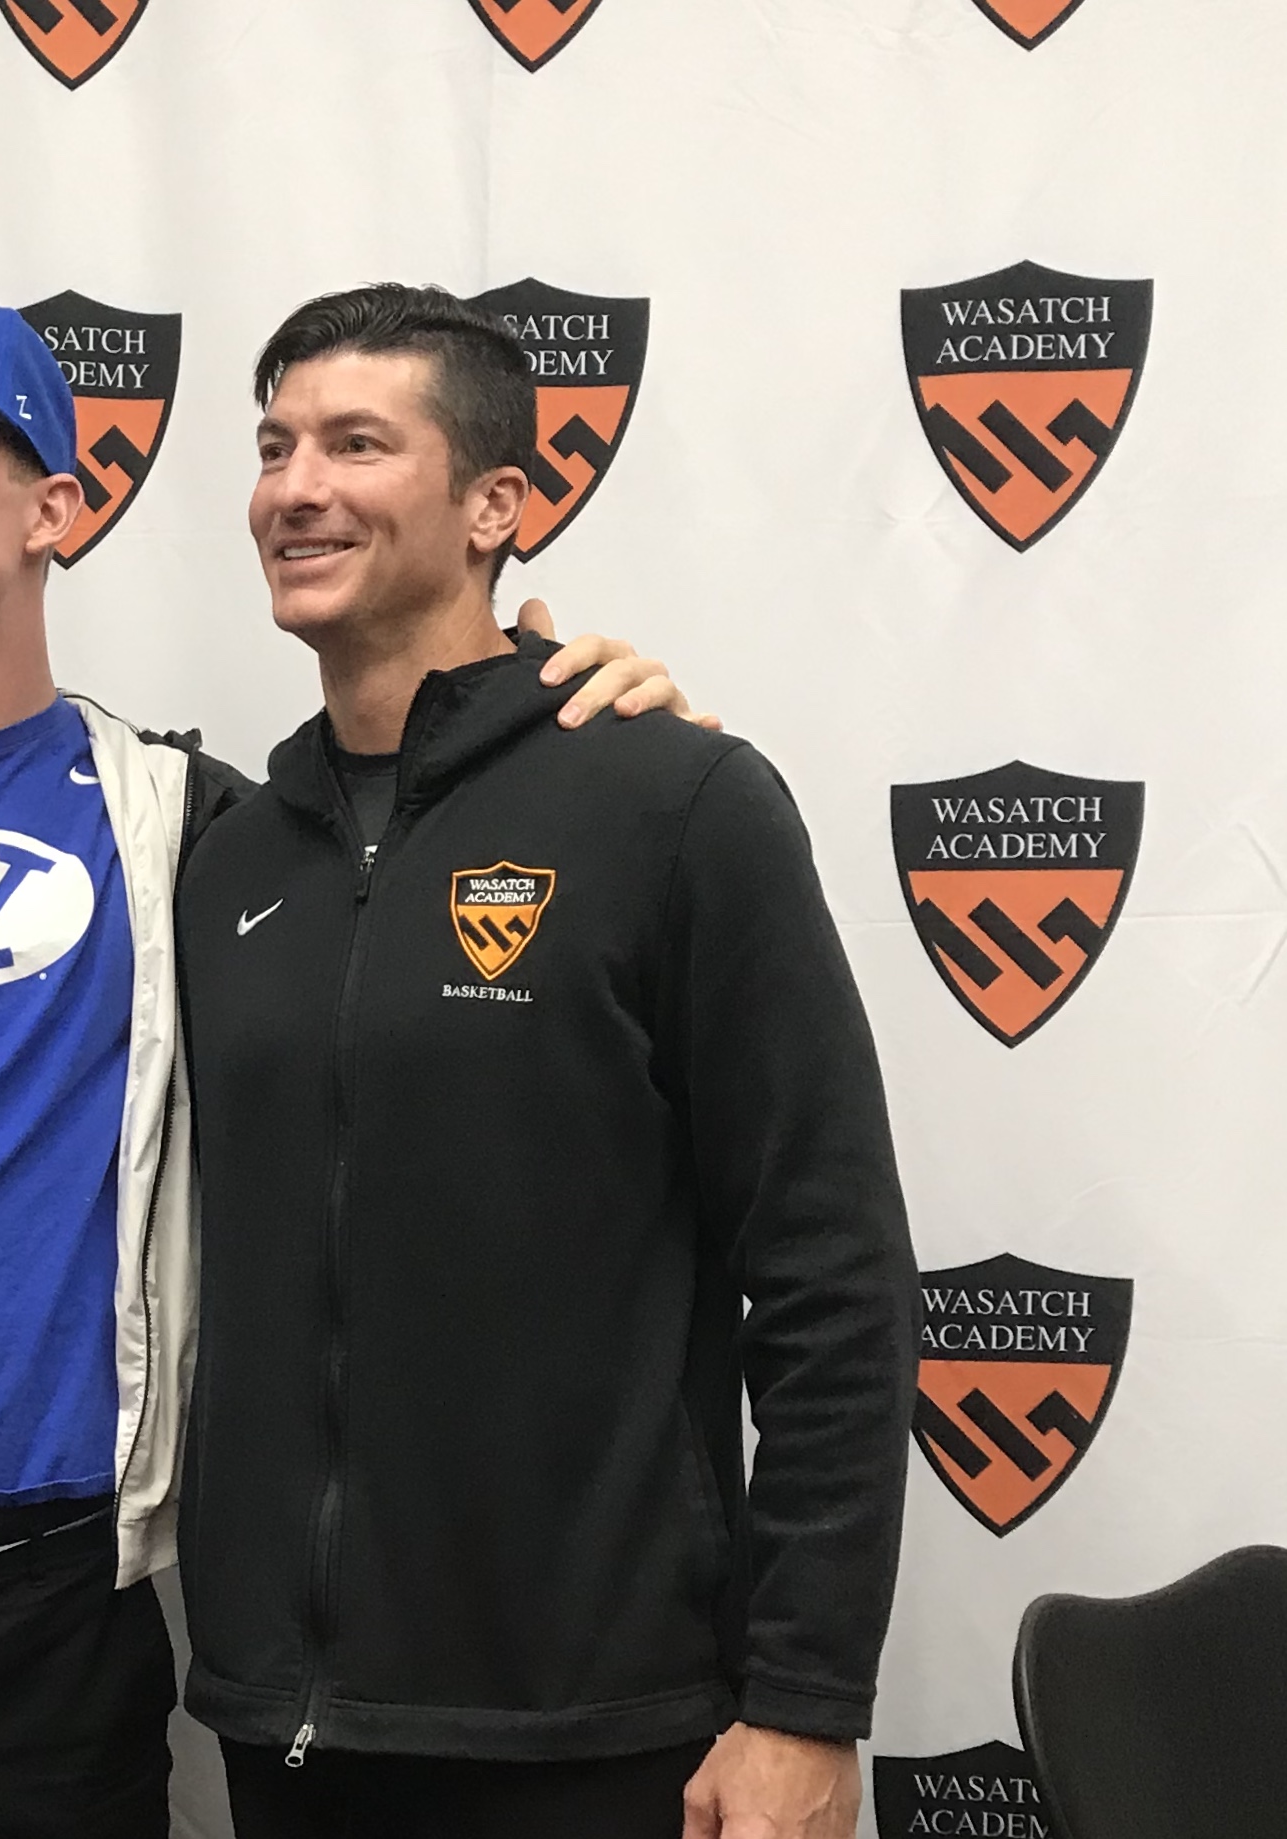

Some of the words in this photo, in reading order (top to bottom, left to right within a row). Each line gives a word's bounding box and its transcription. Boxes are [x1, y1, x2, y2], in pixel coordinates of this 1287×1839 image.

[941, 296, 1112, 326] WASATCH
[42, 325, 147, 355] SATCH
[503, 313, 611, 341] SATCH
[935, 332, 1115, 364] ACADEMY
[58, 360, 151, 389] DEMY
[931, 796, 1104, 824] WASATCH
[925, 832, 1108, 860] ACADEMY
[464, 891, 536, 903] ACADEMY
[469, 878, 536, 891] WASATCH
[441, 984, 534, 1003] BASKETBALL
[921, 1287, 1093, 1318] WASATCH
[921, 1323, 1097, 1353] ACADEMY
[913, 1774, 1042, 1804] WASAT
[908, 1808, 1050, 1839] ACADEM
